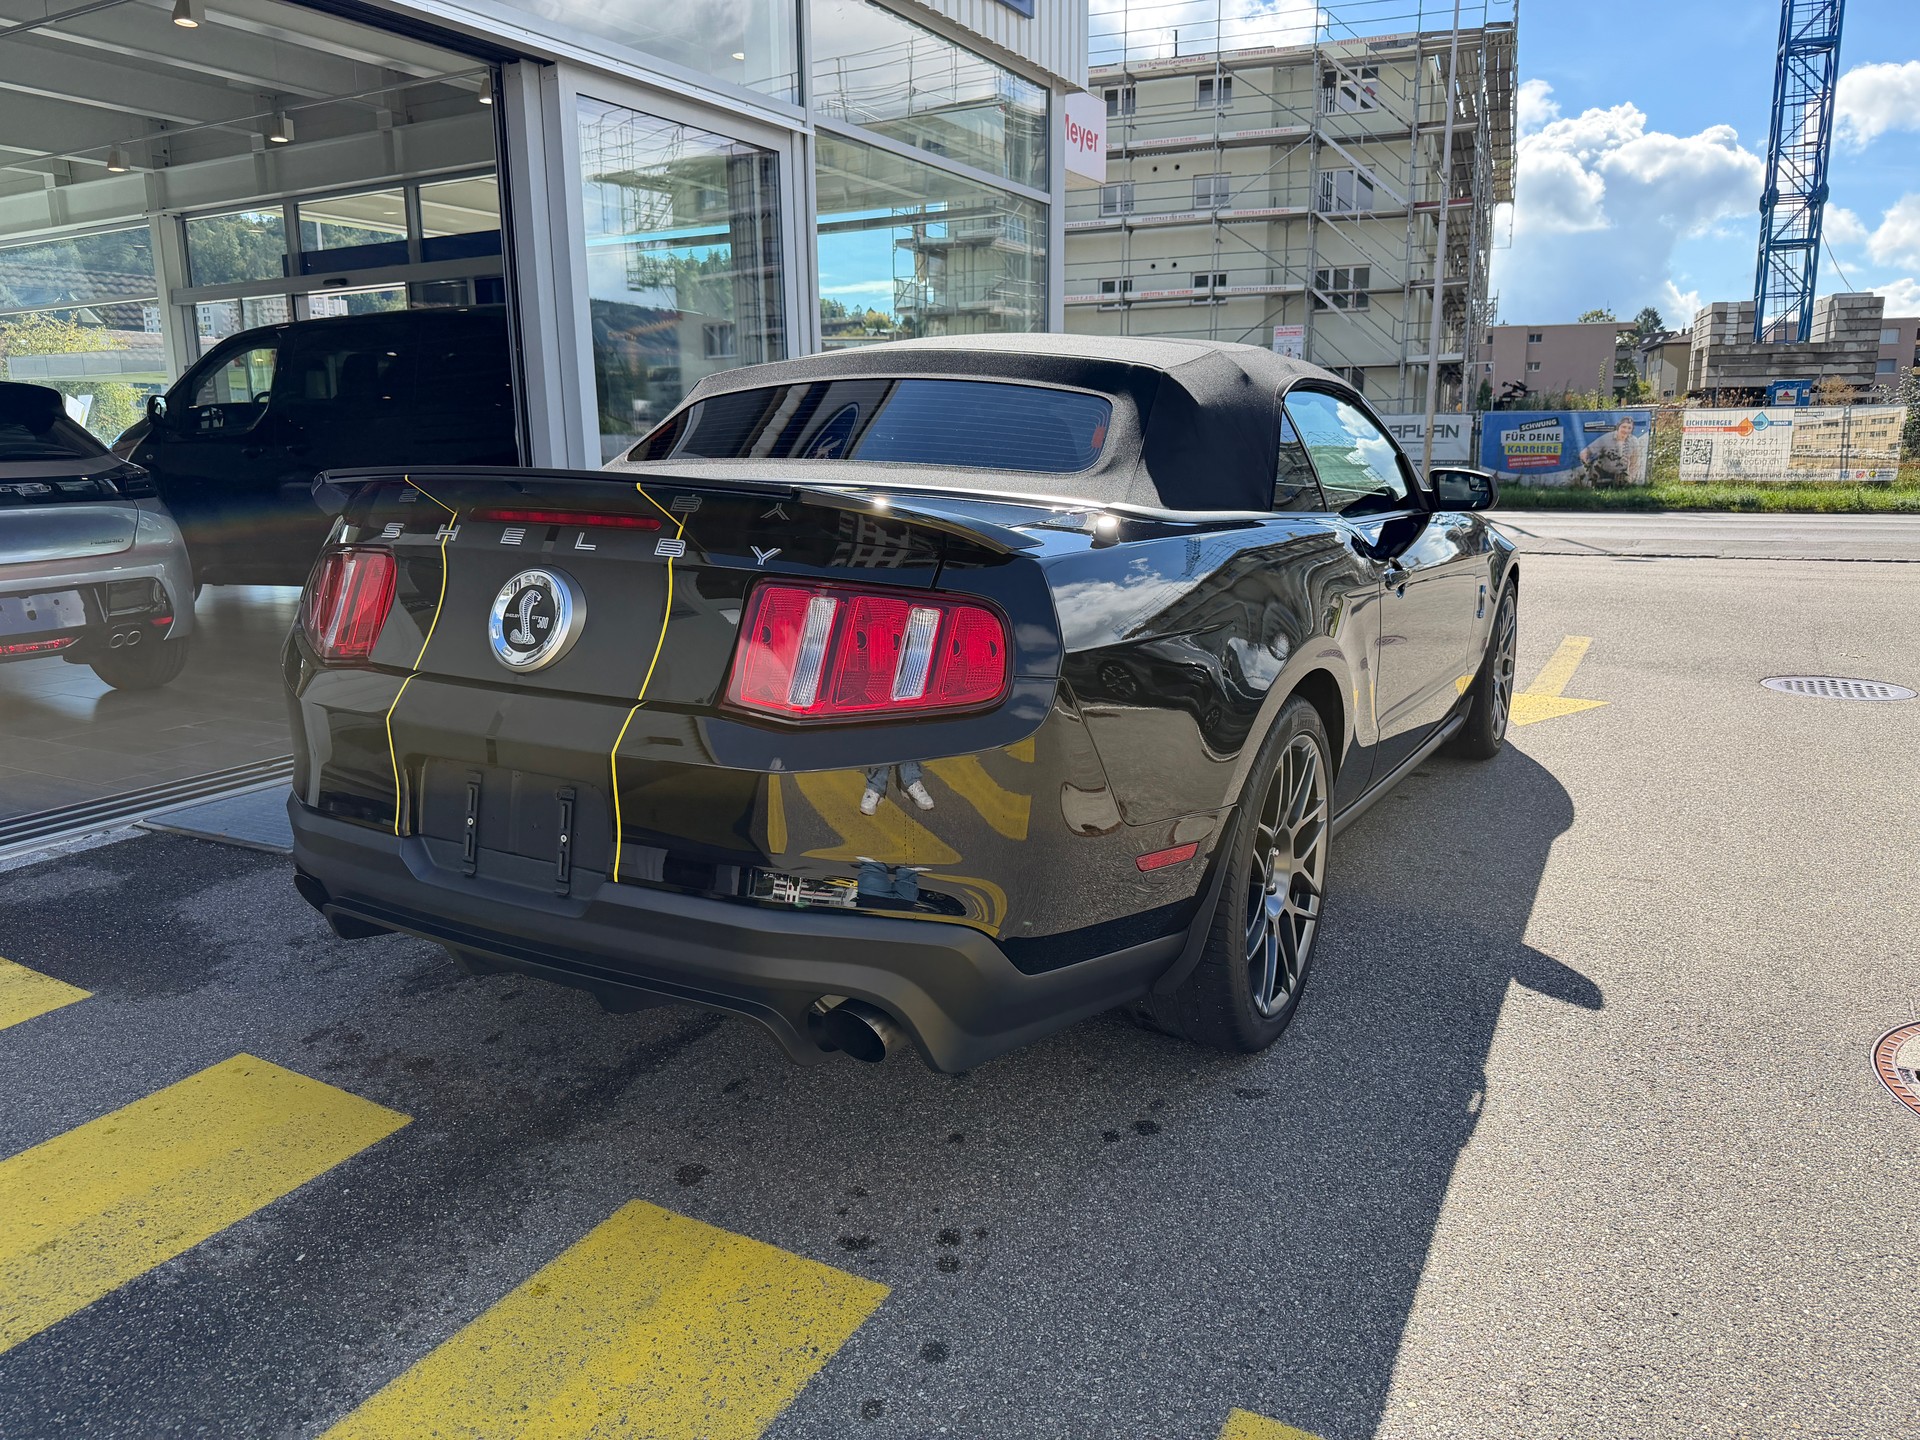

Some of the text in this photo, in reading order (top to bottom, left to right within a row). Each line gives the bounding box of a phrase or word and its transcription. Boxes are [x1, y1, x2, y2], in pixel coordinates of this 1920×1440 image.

[1149, 60, 1168, 68] Schmid
[1521, 418, 1557, 431] SCHWUNG
[1505, 431, 1561, 441] FÜR DEINE
[1507, 445, 1559, 454] KARRIERE
[381, 522, 782, 566] SHELBY
